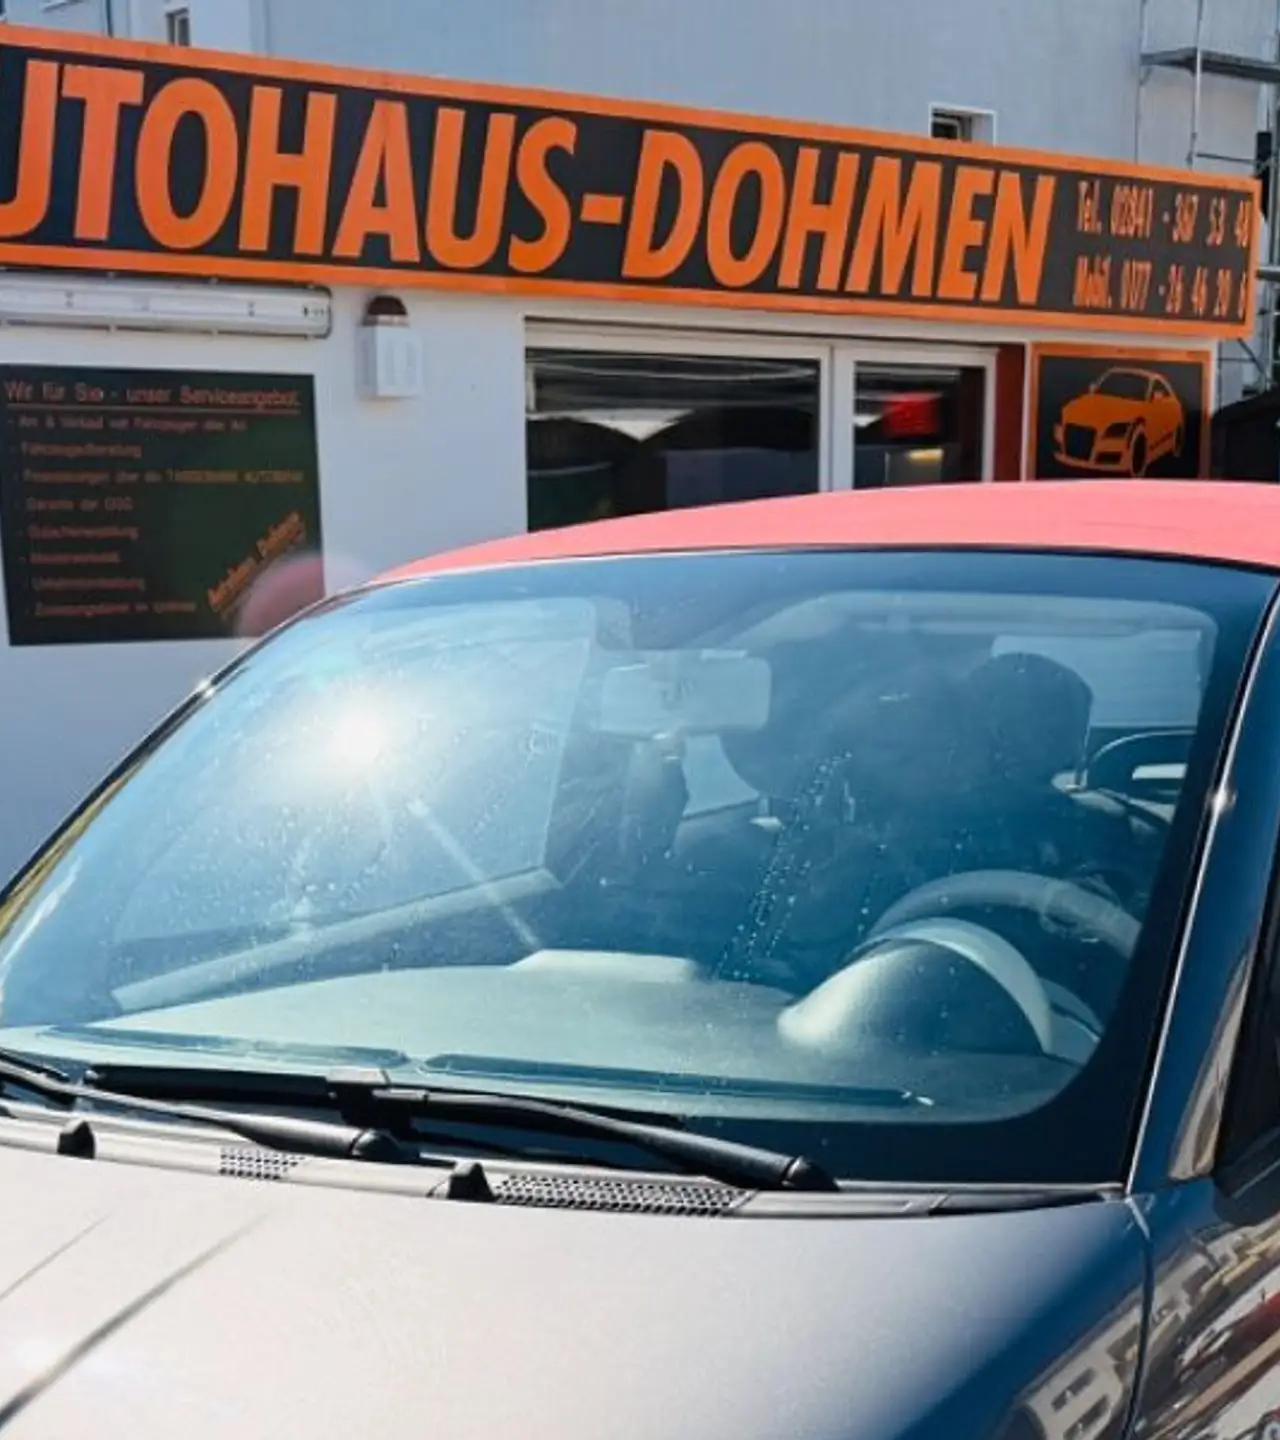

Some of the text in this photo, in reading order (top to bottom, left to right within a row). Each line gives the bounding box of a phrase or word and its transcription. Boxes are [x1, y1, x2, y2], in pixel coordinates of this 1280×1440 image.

[1077, 179, 1102, 235] Tel.
[3, 380, 33, 401] Wir
[42, 382, 66, 400] für
[74, 382, 104, 402] Sie
[126, 387, 172, 403] unser
